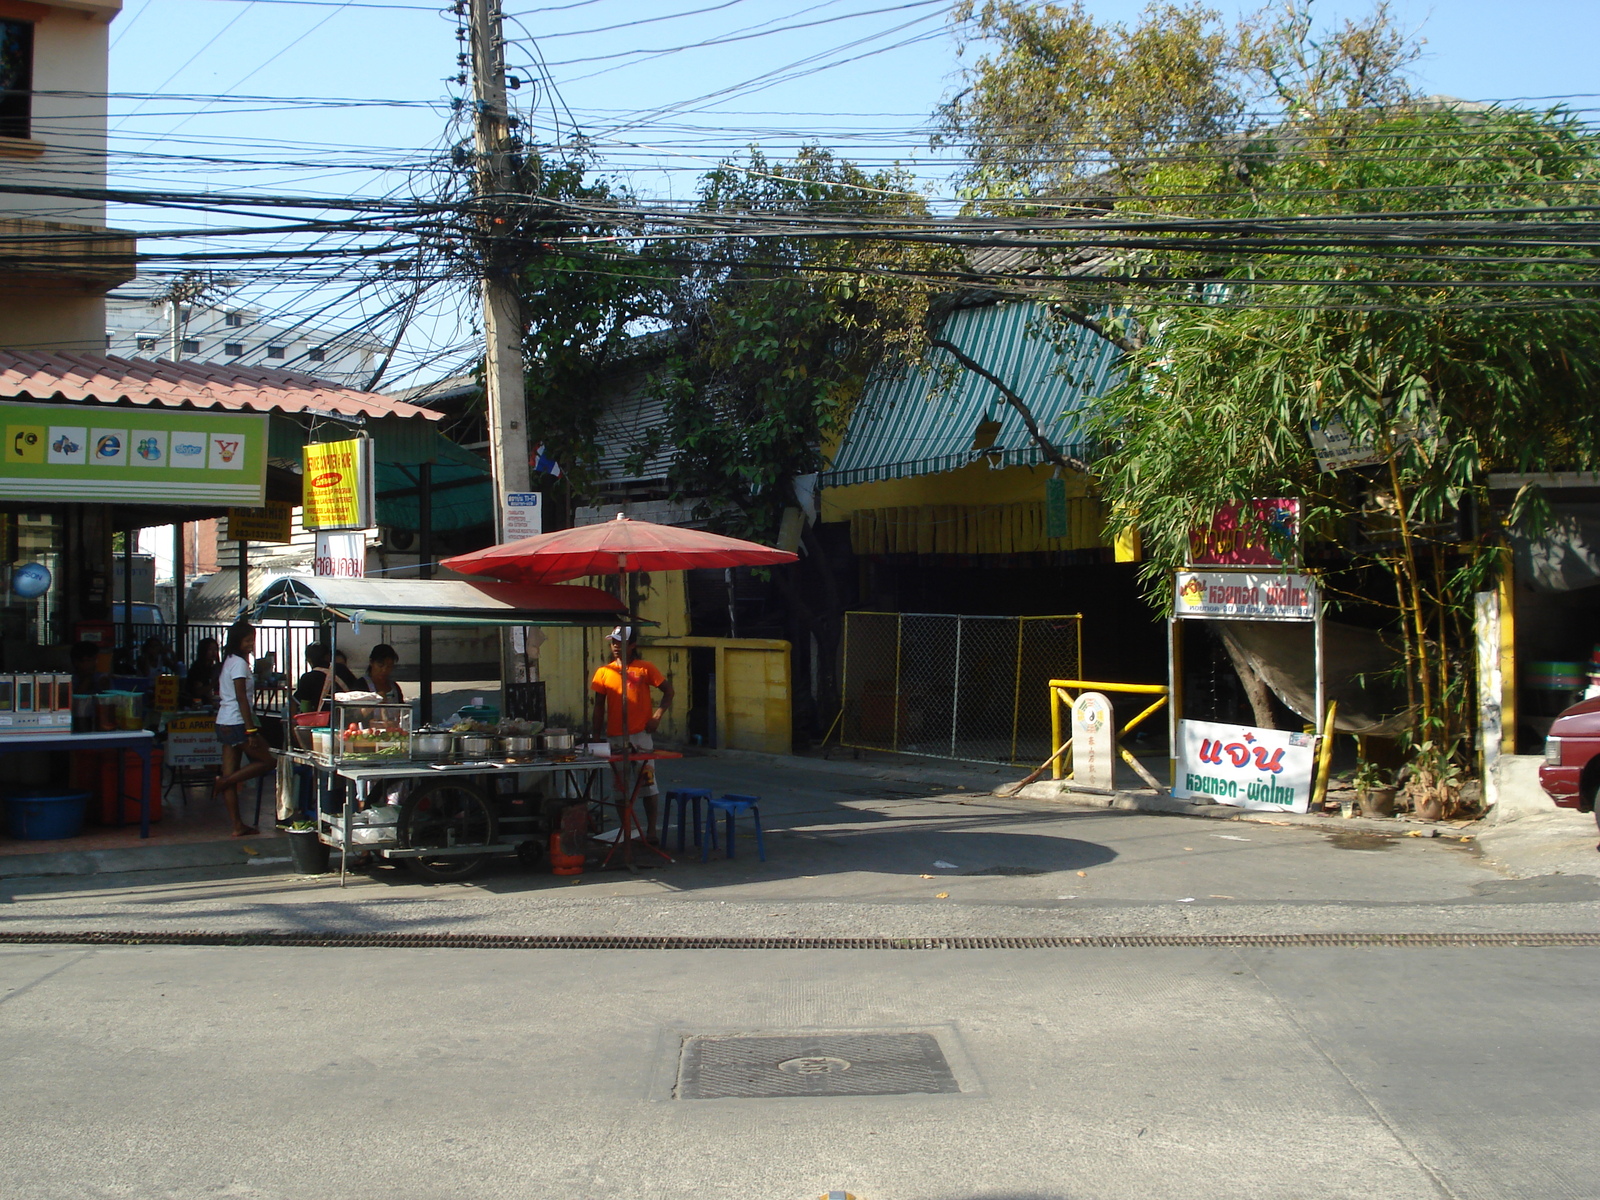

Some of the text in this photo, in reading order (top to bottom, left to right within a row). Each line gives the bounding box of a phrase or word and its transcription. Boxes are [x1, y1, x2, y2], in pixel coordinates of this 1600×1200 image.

[175, 444, 201, 456] skype
[1208, 585, 1259, 604] หอยทอด
[1266, 577, 1307, 605] ผัดไทย
[1199, 732, 1286, 774] แจ๋น
